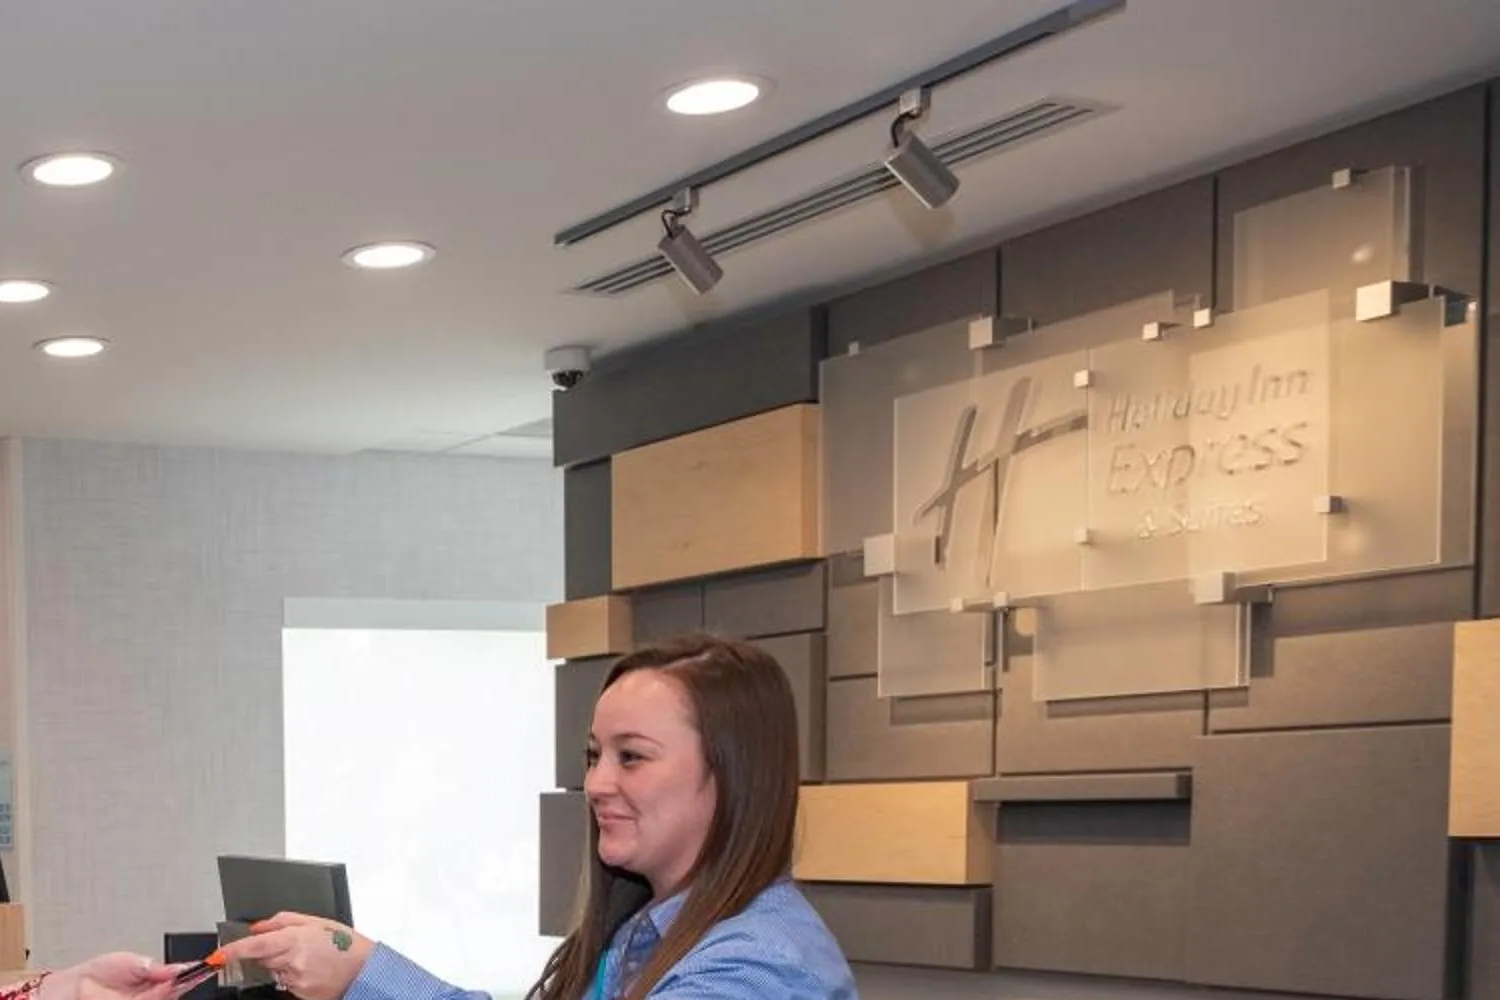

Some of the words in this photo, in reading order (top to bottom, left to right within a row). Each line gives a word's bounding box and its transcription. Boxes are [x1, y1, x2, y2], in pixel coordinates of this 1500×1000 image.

[1107, 381, 1241, 434] Holiday
[1249, 364, 1308, 404] Inn
[1108, 420, 1309, 498] Express
